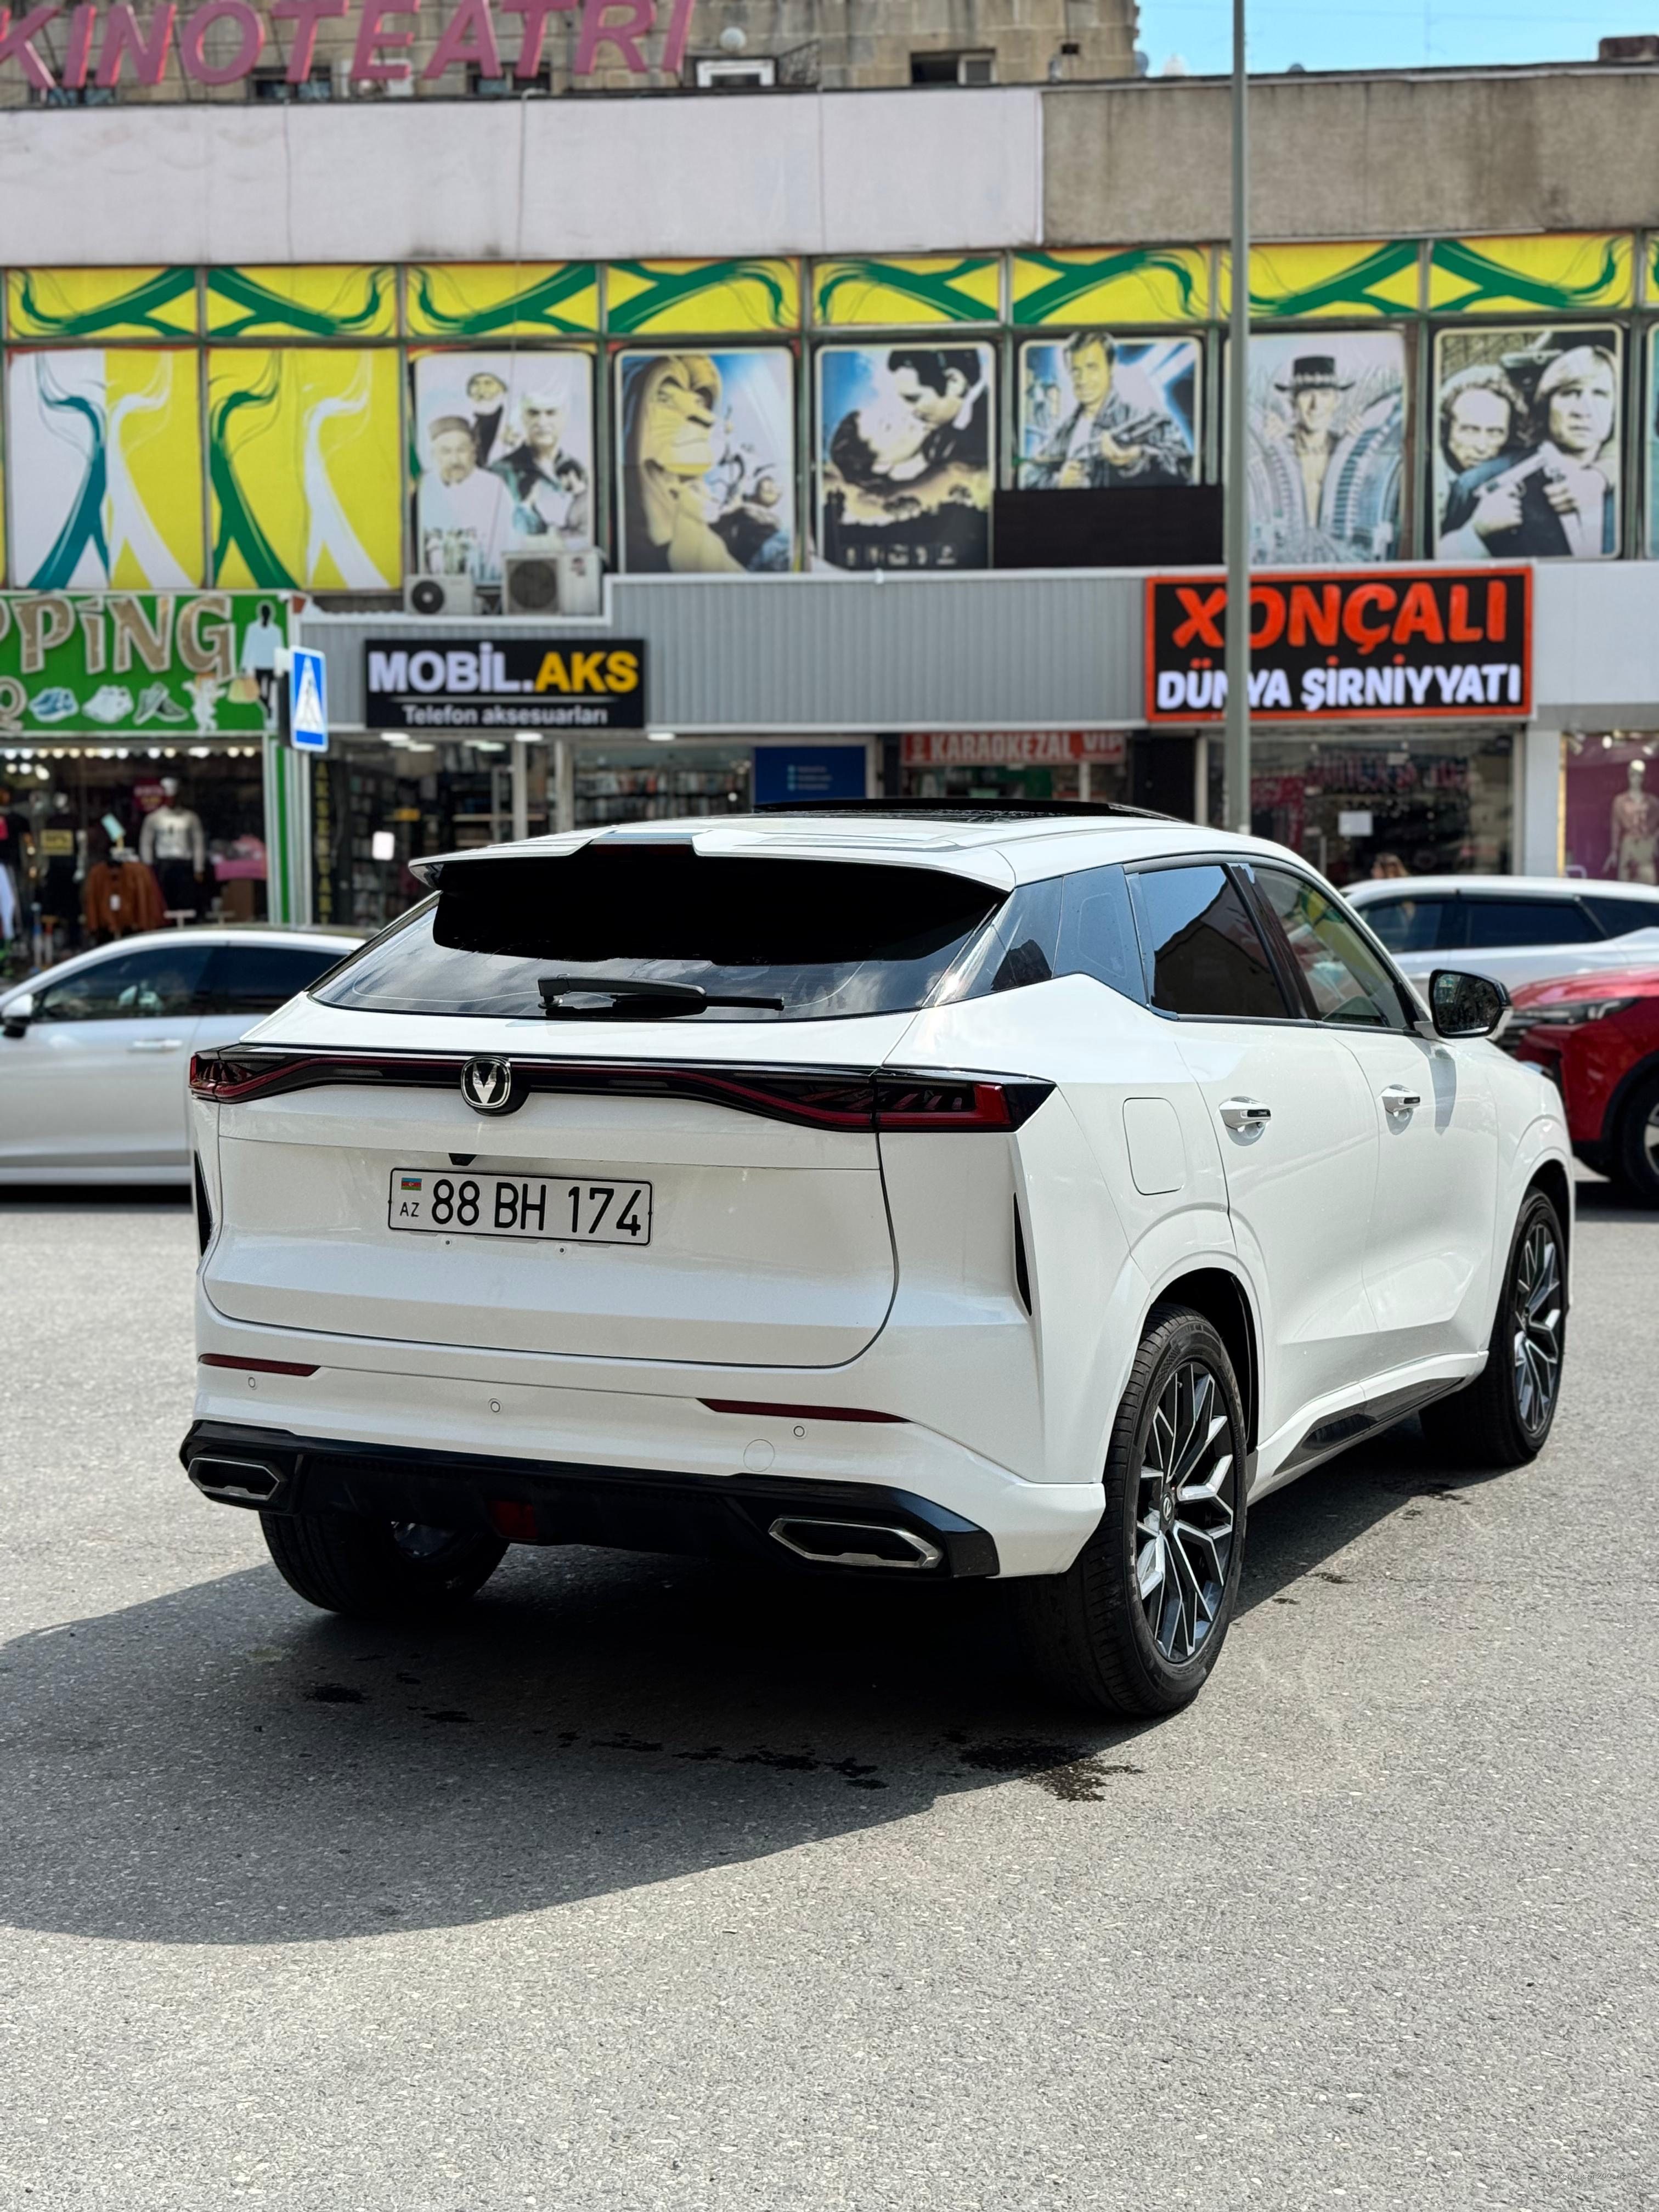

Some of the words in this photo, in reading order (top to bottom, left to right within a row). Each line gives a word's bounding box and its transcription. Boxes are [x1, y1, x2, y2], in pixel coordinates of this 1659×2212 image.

[1172, 580, 1507, 654] XONÇALI
[1300, 653, 1521, 712] ŞİRNİYYATI
[402, 704, 478, 725] Telefon
[1082, 731, 1123, 751] VIP
[399, 1201, 420, 1217] AZ
[431, 1178, 481, 1226] 88
[494, 1182, 547, 1231] BH
[568, 1186, 642, 1237] 174
